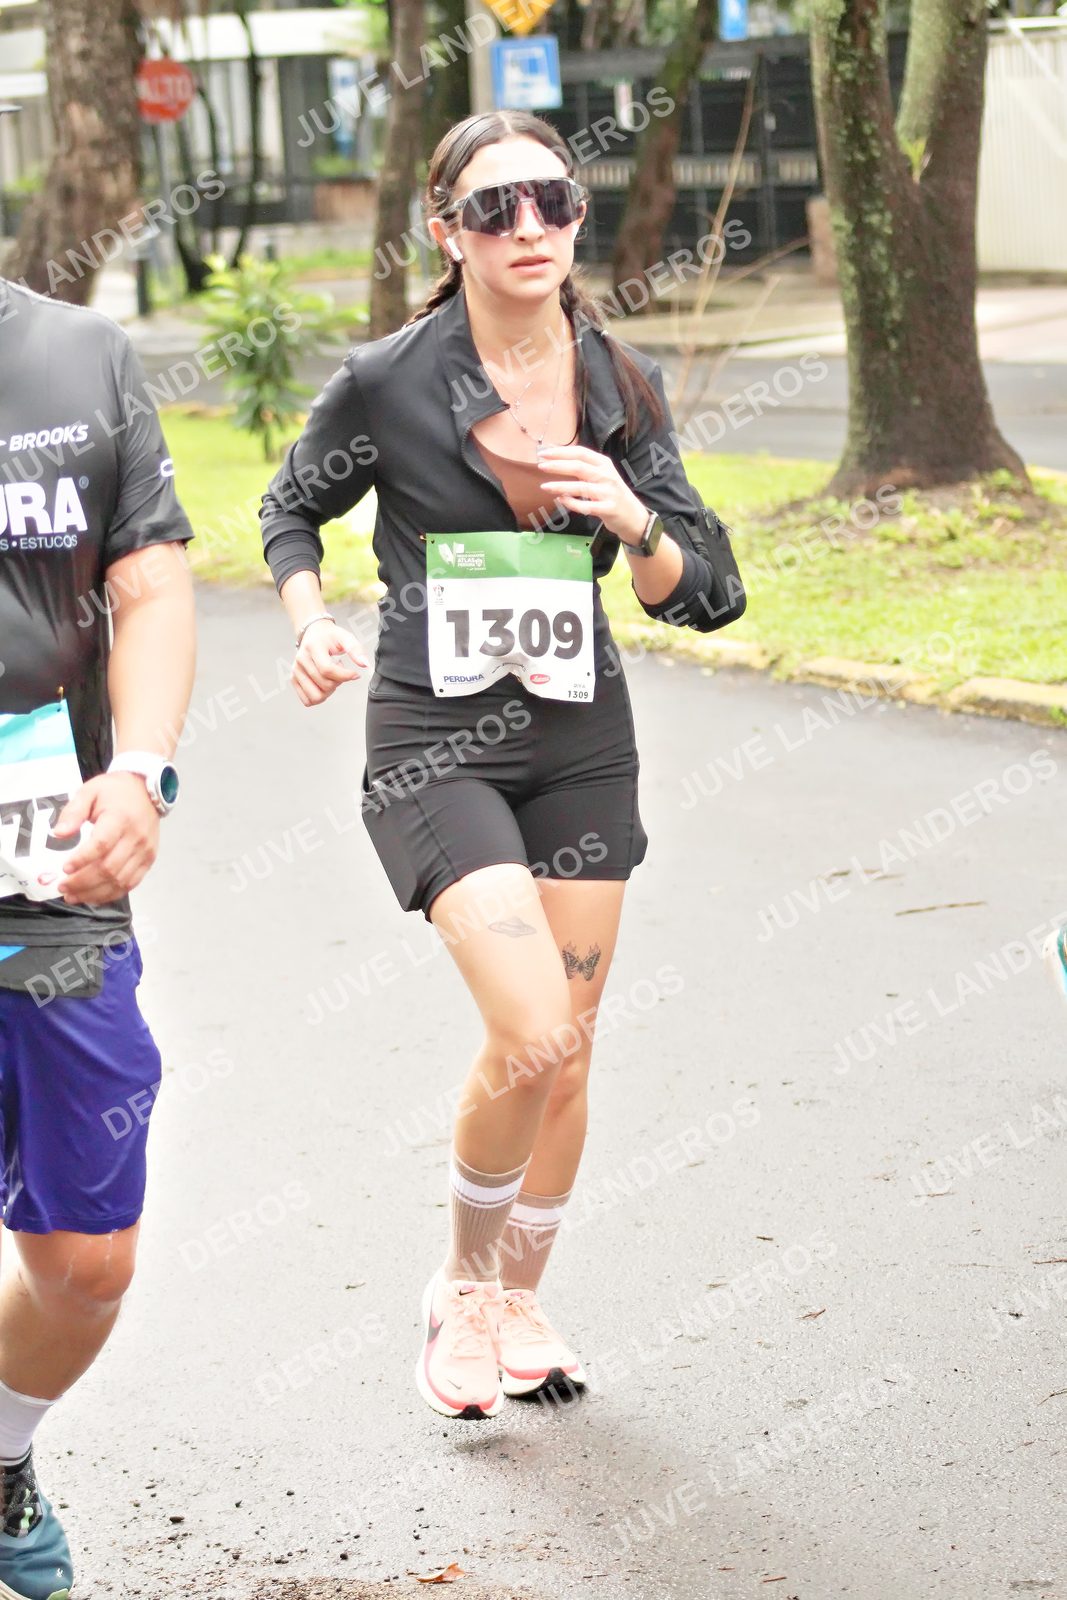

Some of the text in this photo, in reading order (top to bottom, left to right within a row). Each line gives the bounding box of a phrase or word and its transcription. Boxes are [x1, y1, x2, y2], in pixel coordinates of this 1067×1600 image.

[9, 424, 89, 452] BROOKS
[0, 477, 88, 536] RA
[20, 534, 78, 550] ESTUCOS
[445, 608, 584, 660] 1309
[443, 673, 485, 683] PERDURA
[567, 690, 589, 700] 1309
